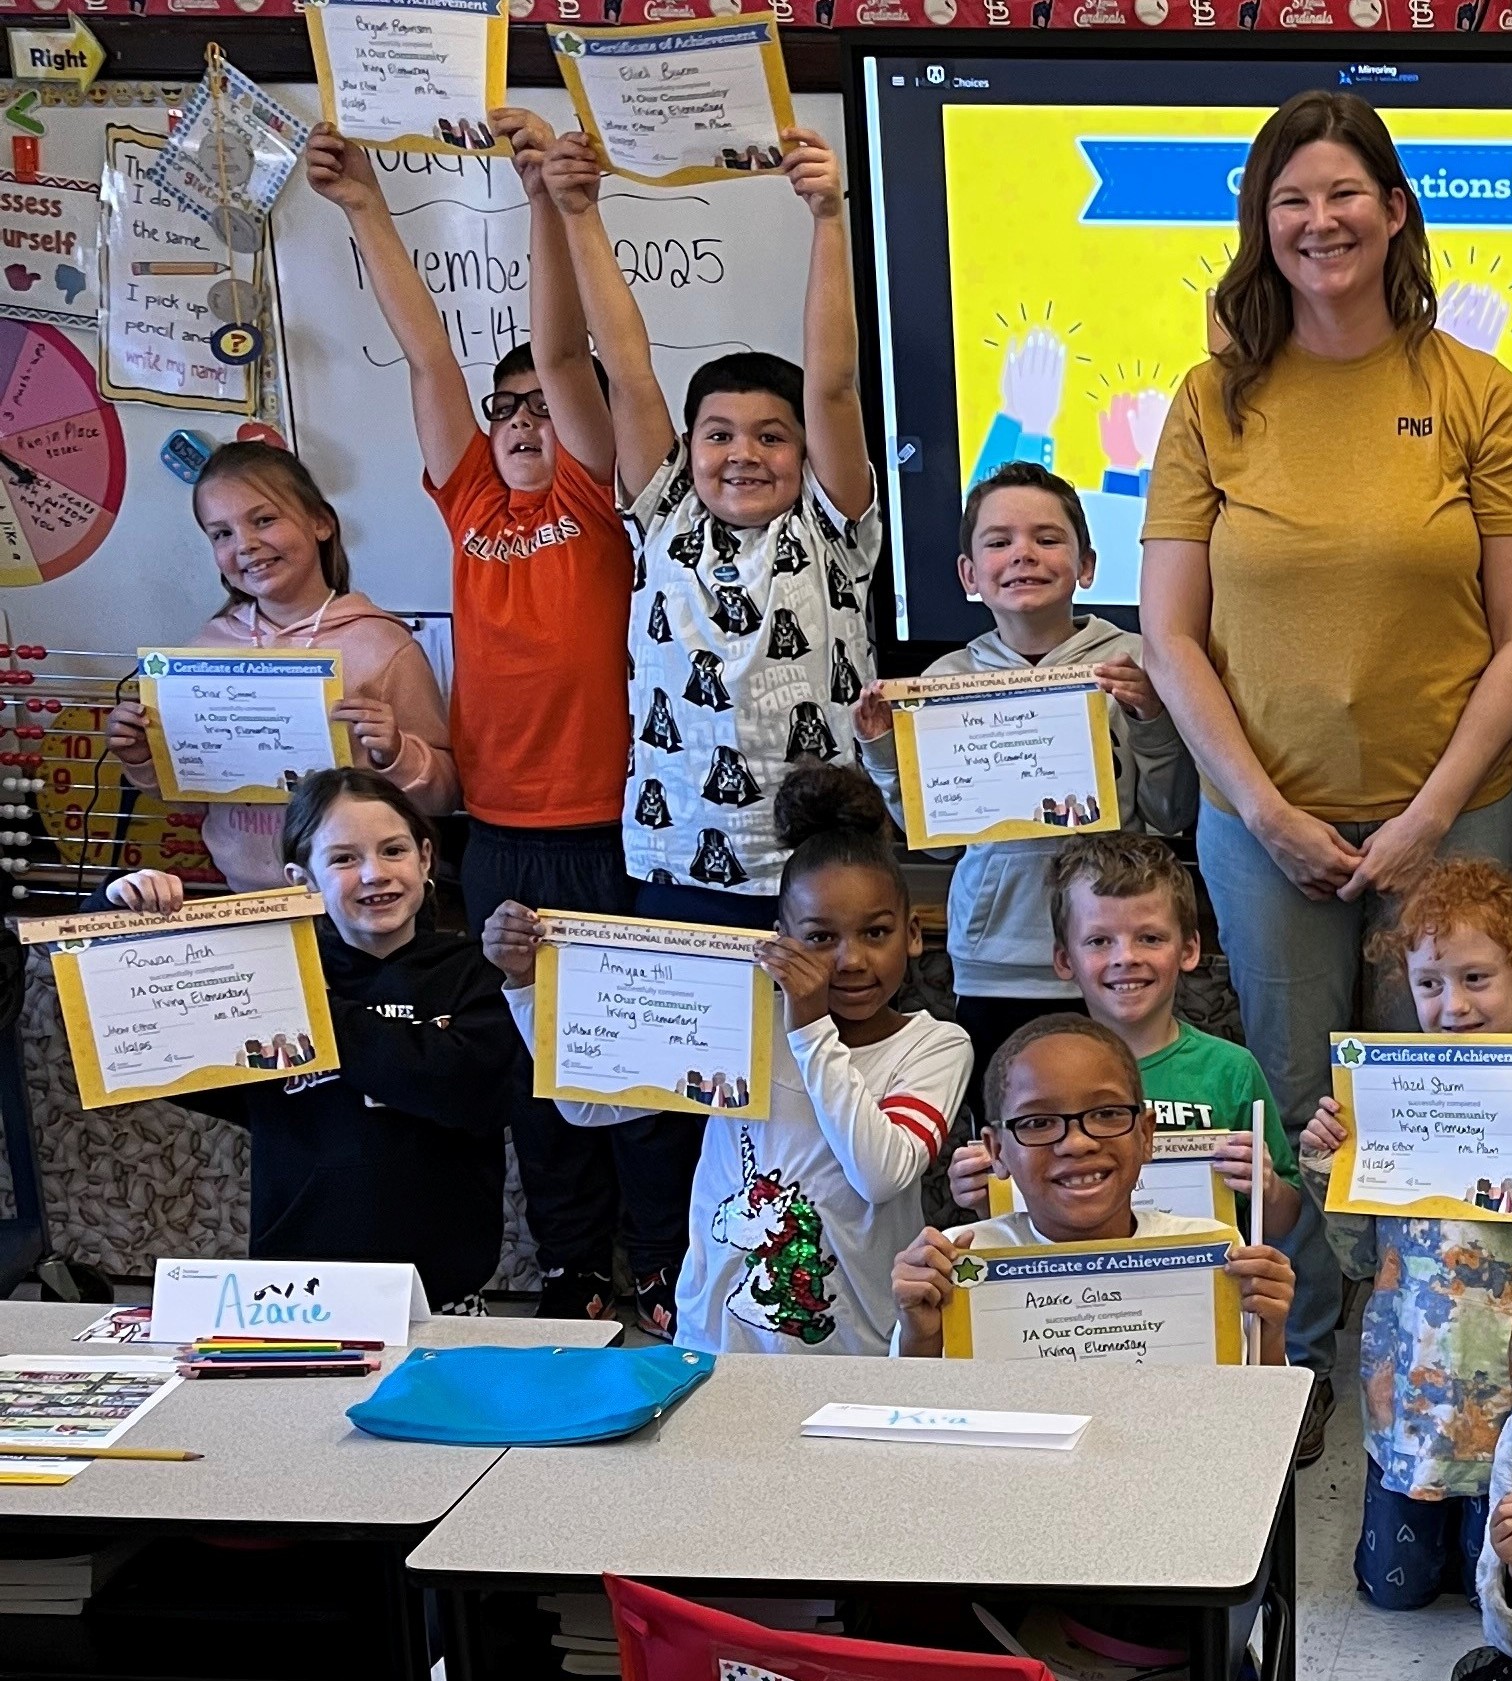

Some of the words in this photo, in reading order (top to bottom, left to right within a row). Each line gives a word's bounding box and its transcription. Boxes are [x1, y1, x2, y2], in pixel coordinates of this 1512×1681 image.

[30, 47, 88, 72] Right
[1358, 65, 1397, 77] Mirroring
[954, 78, 989, 88] Choices
[133, 220, 160, 241] the
[166, 231, 210, 251] same
[613, 238, 725, 289] 2025
[126, 284, 138, 302] I
[145, 293, 180, 317] pick
[186, 302, 209, 325] up
[125, 320, 174, 340] pencil
[182, 330, 213, 344] and
[126, 348, 162, 372] write
[166, 359, 185, 386] my
[1398, 417, 1432, 437] PNB
[922, 680, 961, 692] PEOPLES
[962, 677, 1006, 689] NATIONAL
[1008, 675, 1031, 685] BANK
[1033, 674, 1045, 682] OF
[1048, 670, 1091, 681] KEWANEE
[61, 736, 92, 760] 10
[53, 769, 71, 795] 9
[65, 804, 83, 830] 8
[123, 840, 141, 866] 6
[78, 918, 127, 932] PEOPLES
[129, 913, 183, 928] NATIONAL
[184, 910, 216, 921] BANK
[218, 909, 233, 918] OF
[235, 903, 287, 917] KEWANEE
[568, 928, 610, 940] PEOPLES
[612, 931, 661, 944] NATIONAL
[664, 936, 691, 946] BANK
[694, 938, 707, 948] OF
[185, 943, 215, 959] Arch
[651, 965, 673, 980] Hill
[1370, 1049, 1436, 1063] Certificate
[1438, 1050, 1452, 1062] of
[1391, 1075, 1424, 1091] Hazel
[1391, 1109, 1404, 1119] JA
[1406, 1109, 1428, 1118] Our
[1430, 1109, 1497, 1121] Community
[995, 1260, 1082, 1278] Certificate
[1086, 1258, 1104, 1271] of
[1106, 1251, 1214, 1269] Achievement
[215, 1273, 331, 1329] Azarie
[1081, 1287, 1122, 1304] Glass
[1022, 1329, 1040, 1342] JA
[1042, 1326, 1072, 1340] Our
[1074, 1319, 1166, 1338] Community
